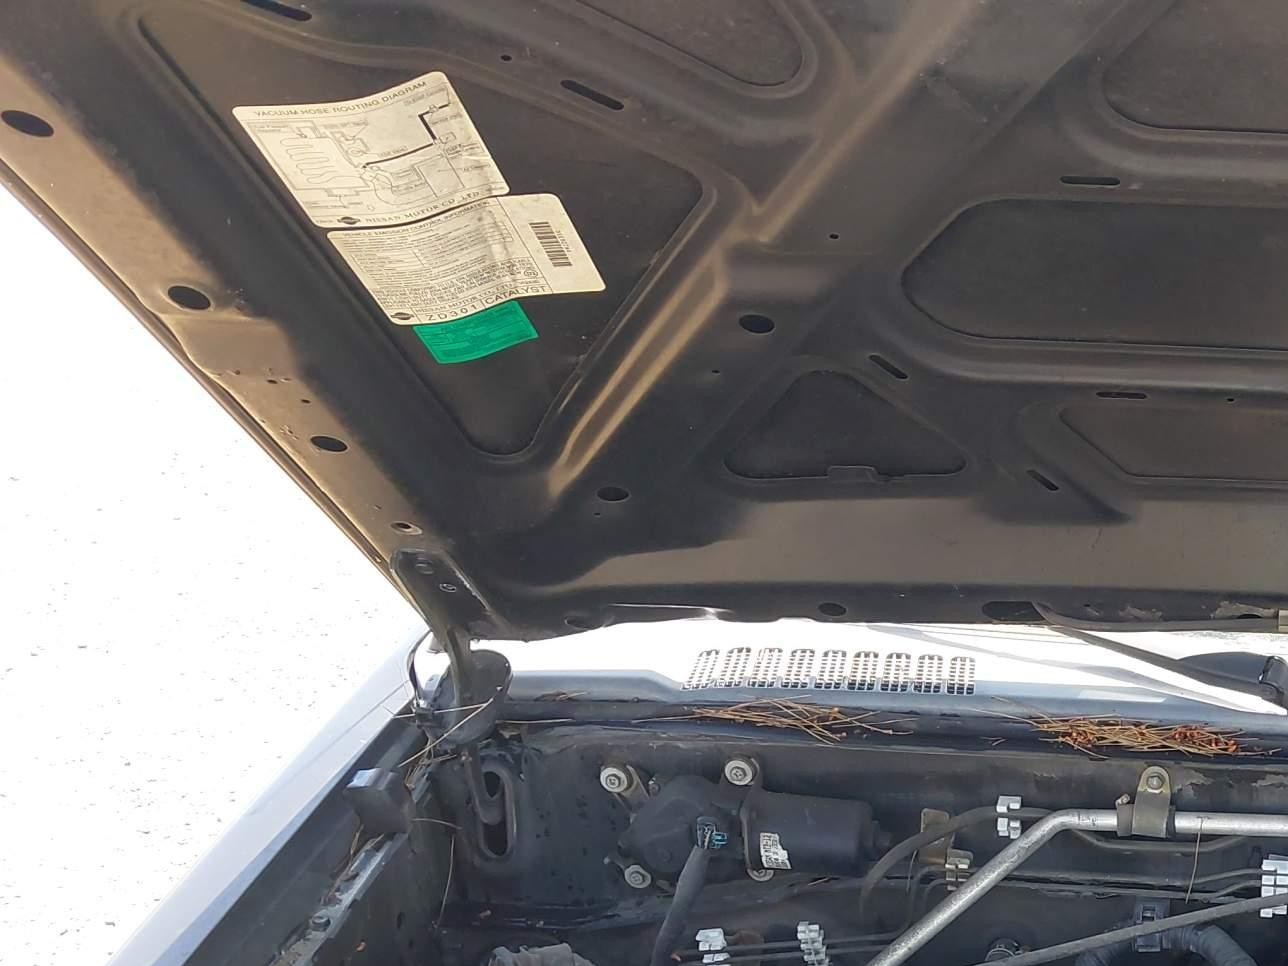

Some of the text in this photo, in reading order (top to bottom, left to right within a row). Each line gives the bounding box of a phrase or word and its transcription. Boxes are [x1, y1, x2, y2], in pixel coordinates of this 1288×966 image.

[254, 109, 297, 117] VACUUM
[300, 107, 329, 115] HOSE
[332, 100, 380, 113] ROUTING
[381, 81, 427, 102] DIAGRAM
[365, 215, 402, 223] NISSAN
[404, 204, 440, 220] MOTOR
[485, 285, 549, 305] CATALYST
[426, 303, 479, 320] ZD301
